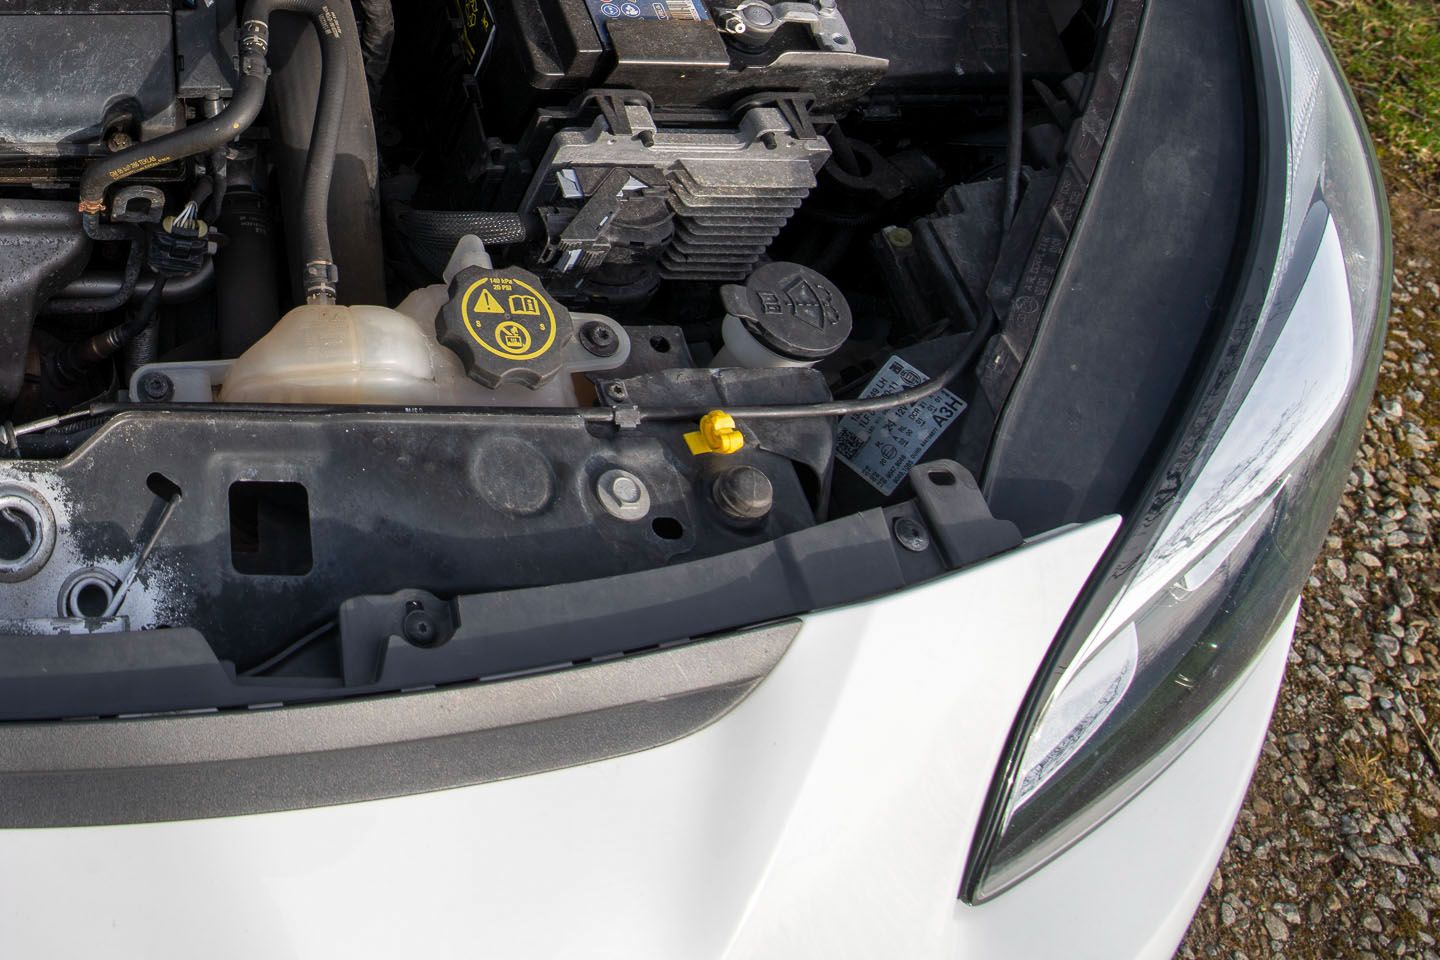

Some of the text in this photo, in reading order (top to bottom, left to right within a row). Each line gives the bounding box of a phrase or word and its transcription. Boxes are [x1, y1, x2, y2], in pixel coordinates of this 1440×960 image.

[876, 377, 888, 389] LH
[908, 407, 921, 420] DCR
[933, 397, 963, 428] A3H
